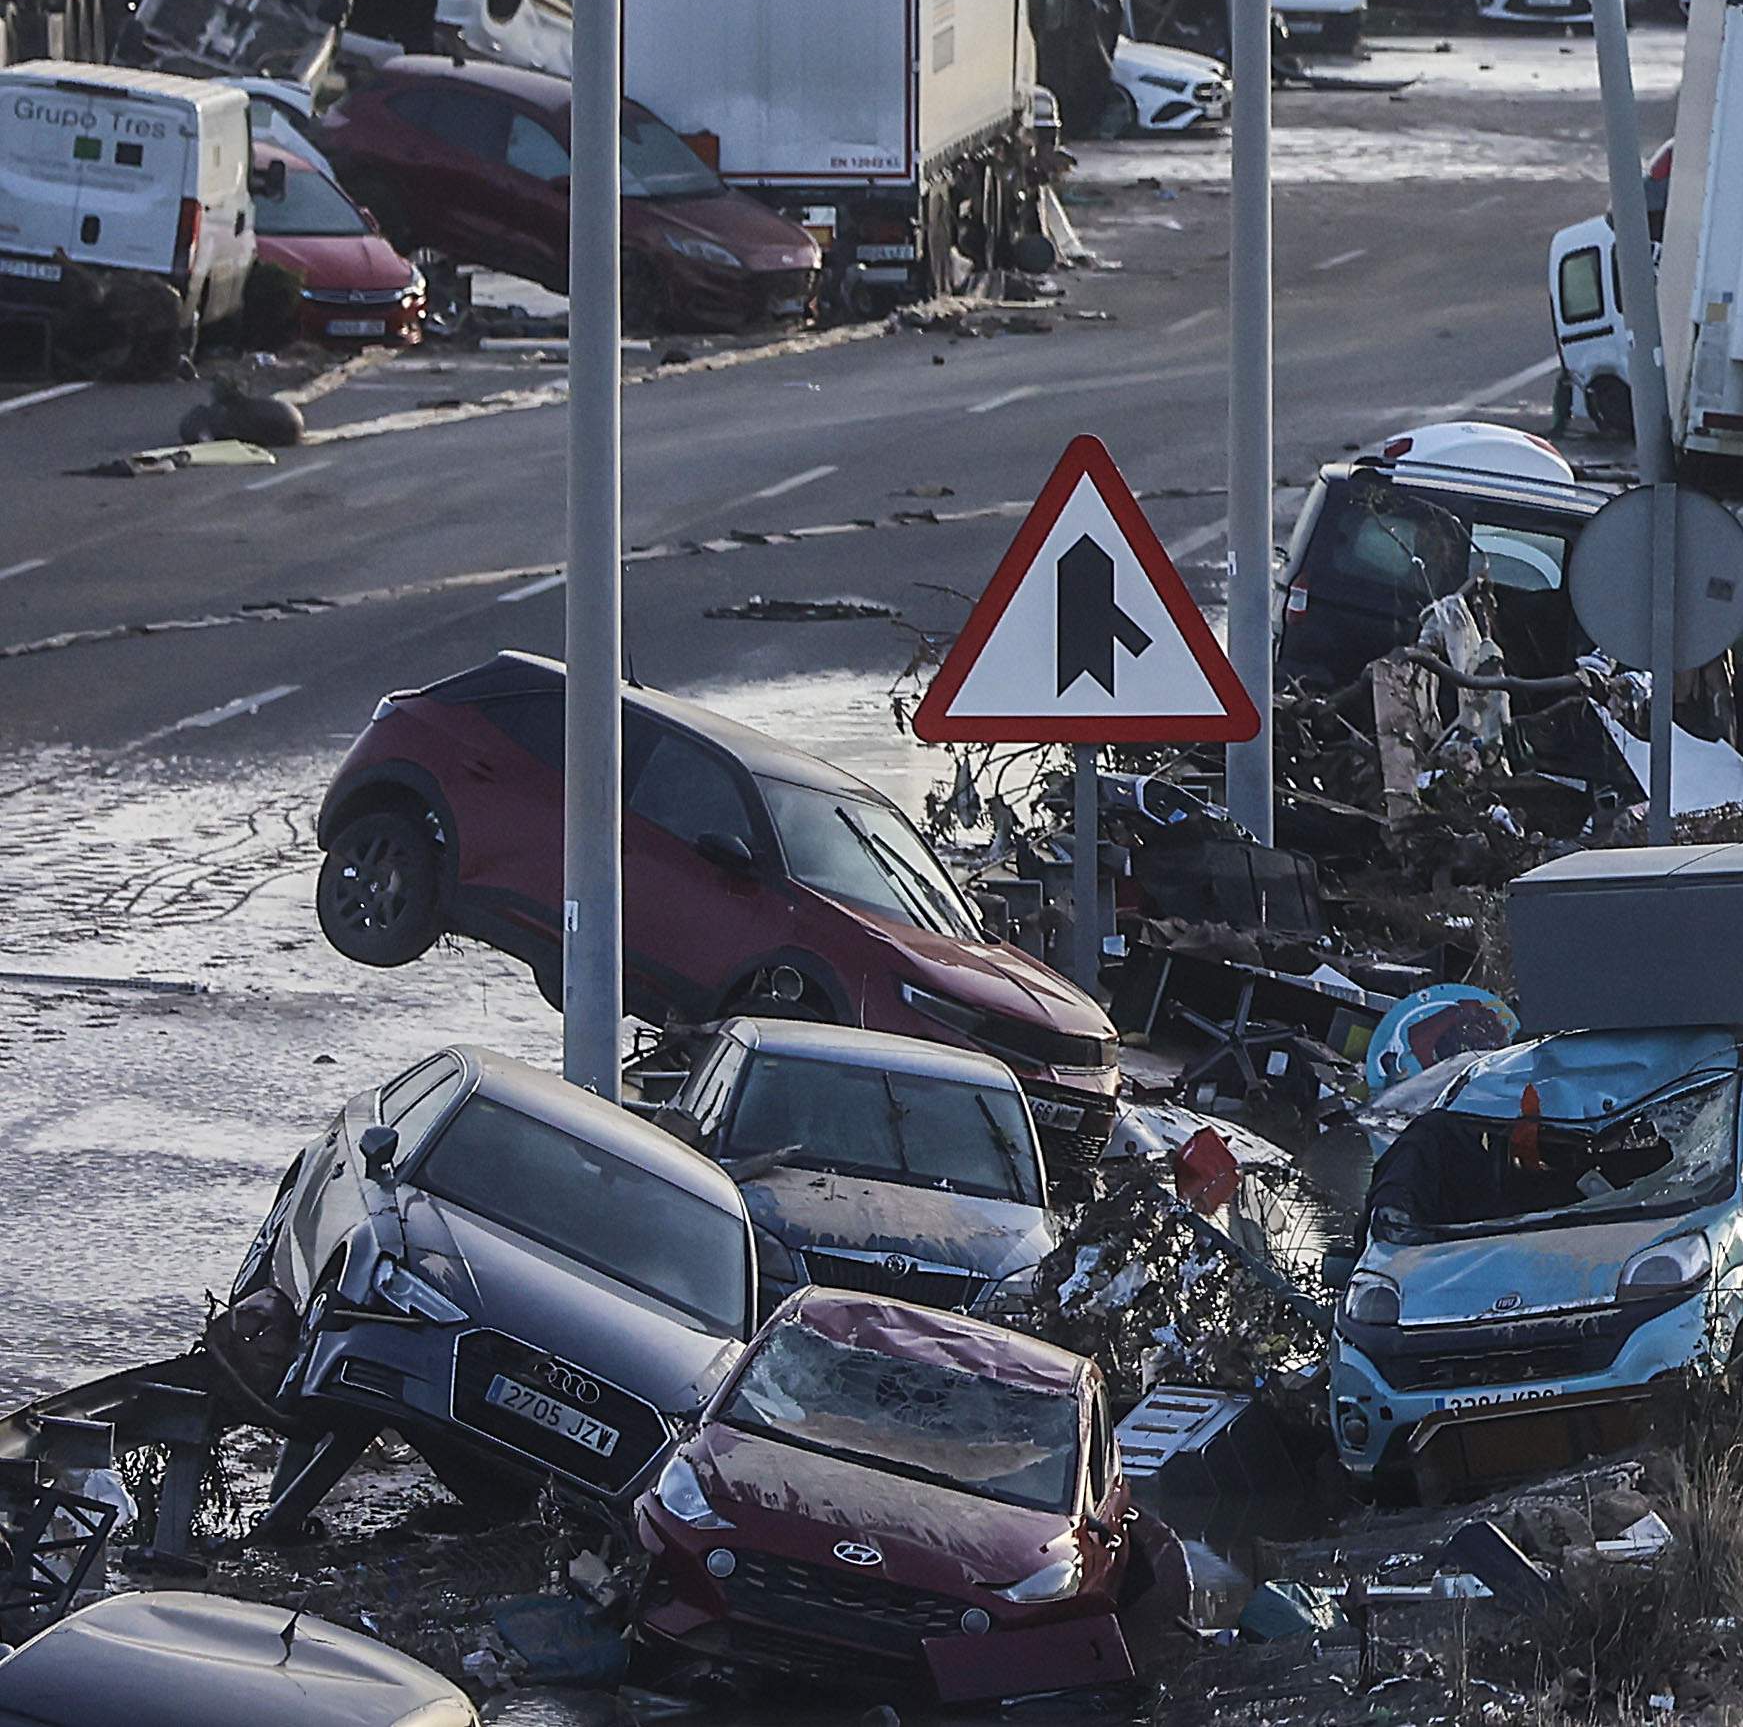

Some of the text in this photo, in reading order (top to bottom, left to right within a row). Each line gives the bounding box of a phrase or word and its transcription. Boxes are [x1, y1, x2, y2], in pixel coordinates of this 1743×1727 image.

[14, 96, 166, 139] Grupo Tres
[503, 1385, 613, 1452] 2705 JZW
